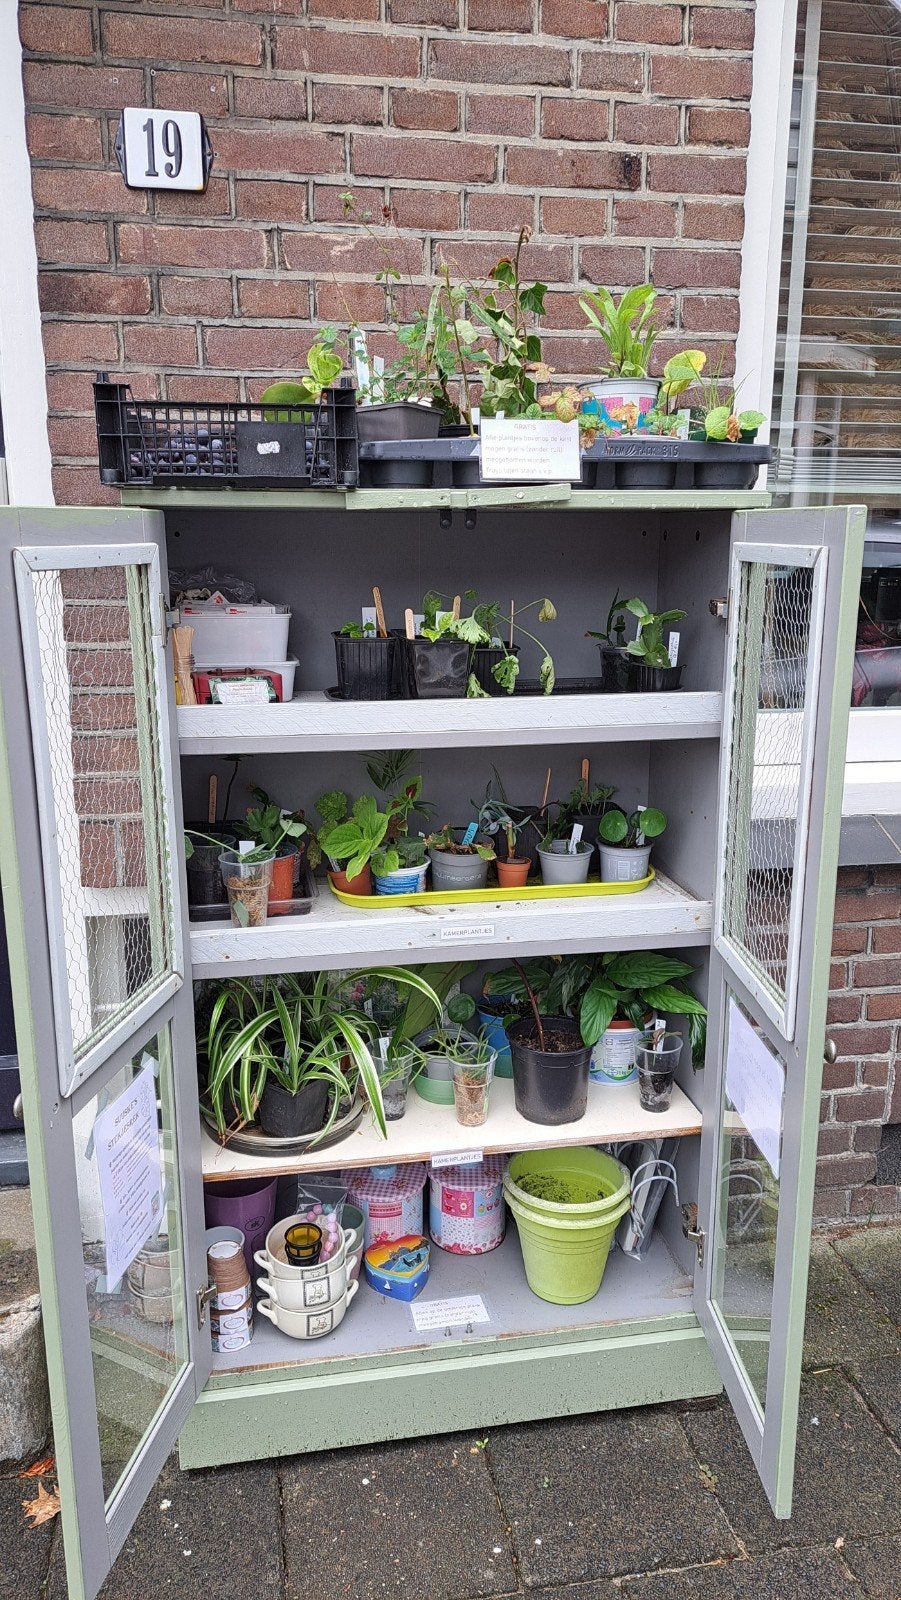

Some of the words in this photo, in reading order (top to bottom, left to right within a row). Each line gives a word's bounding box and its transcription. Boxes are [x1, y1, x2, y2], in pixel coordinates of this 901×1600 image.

[143, 118, 182, 178] 19
[513, 423, 537, 431] GRATIS
[443, 928, 493, 937] KAMERPLANTJES
[433, 1153, 482, 1165] KAMERPLANTJES
